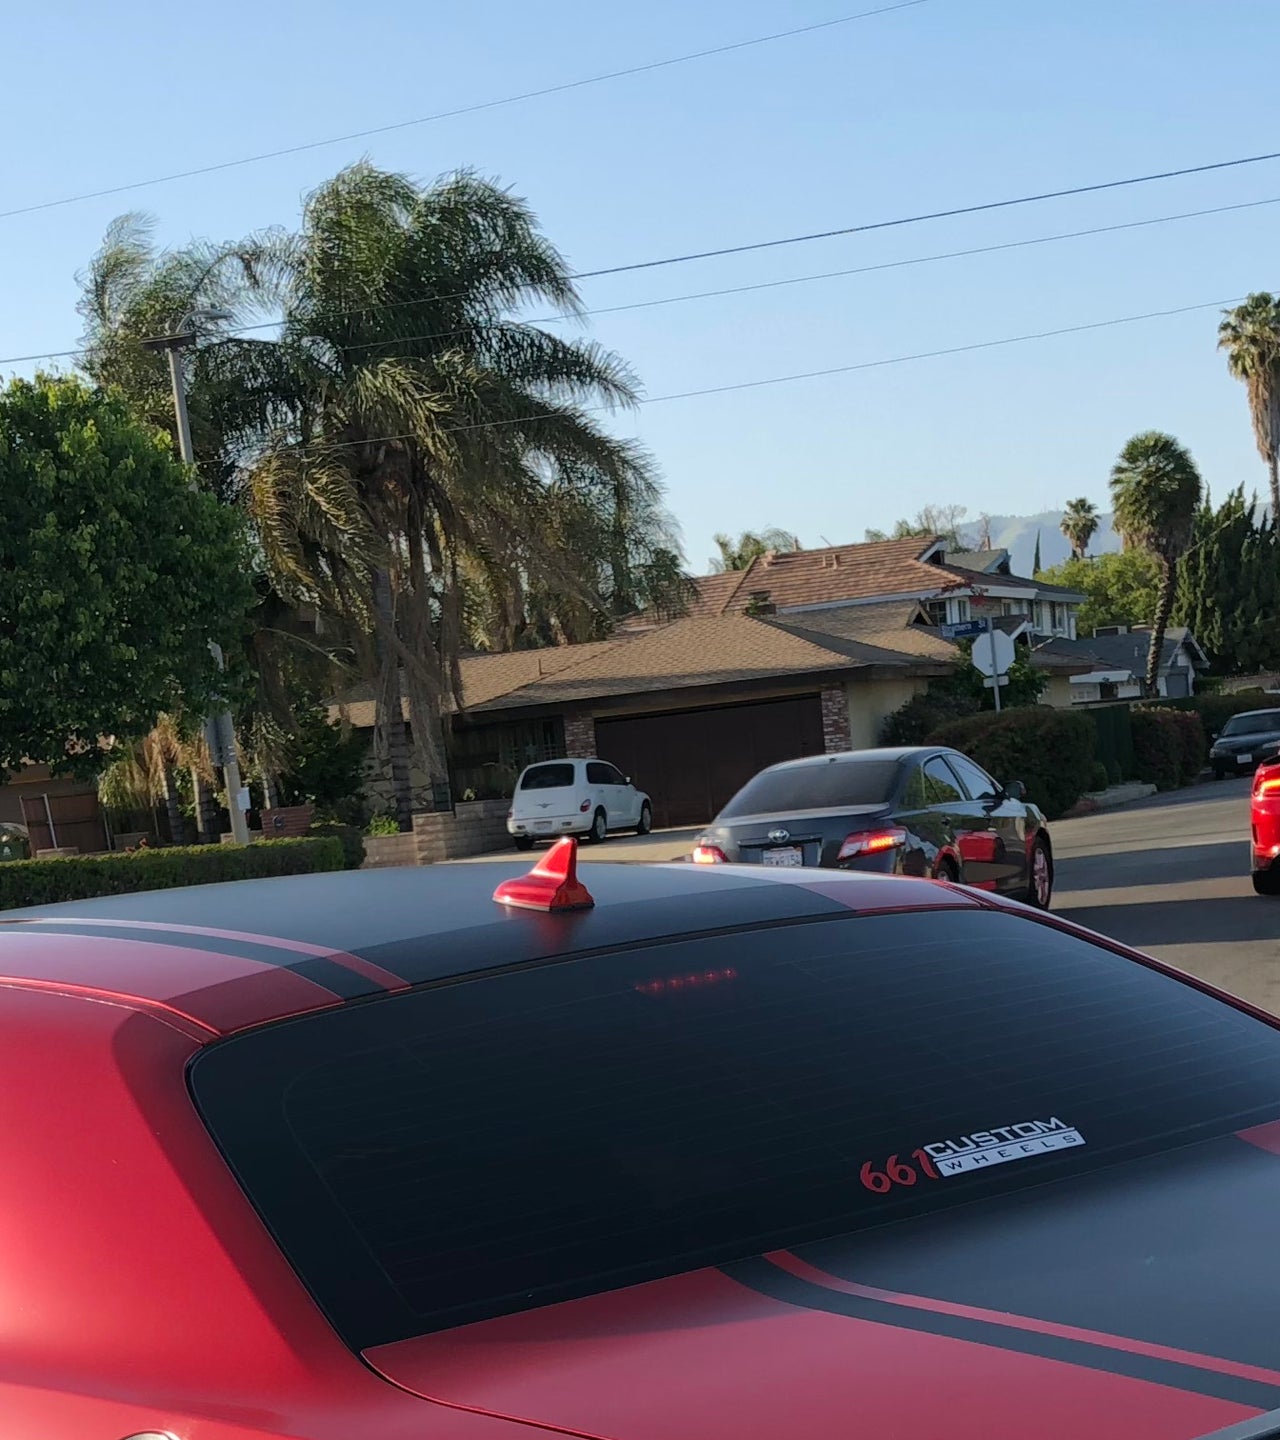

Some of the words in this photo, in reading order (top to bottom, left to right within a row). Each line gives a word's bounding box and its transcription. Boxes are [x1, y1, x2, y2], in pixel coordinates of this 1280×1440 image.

[859, 1149, 939, 1193] 661
[923, 1116, 1068, 1159] CUSTOM
[945, 1134, 1079, 1171] WHEELS
